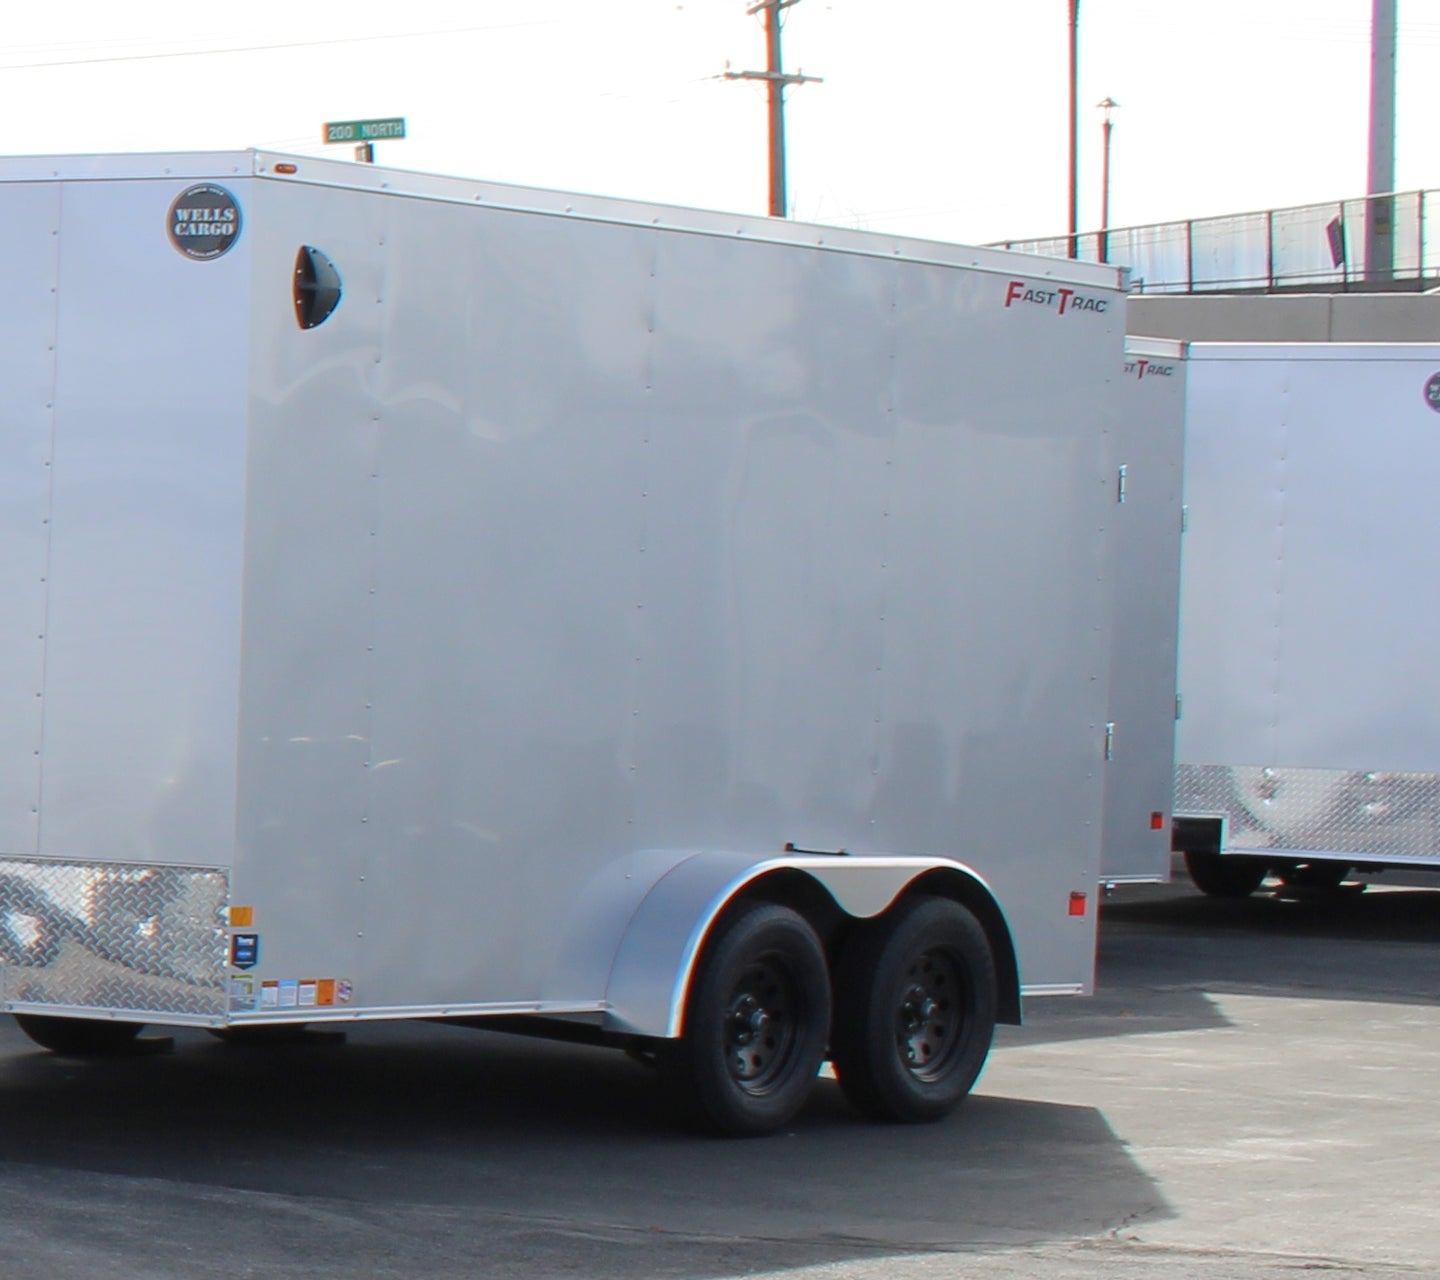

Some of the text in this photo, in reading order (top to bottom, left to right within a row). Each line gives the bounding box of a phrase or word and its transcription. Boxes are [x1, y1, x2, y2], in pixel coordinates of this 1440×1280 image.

[329, 122, 402, 140] 200 NORTH
[175, 208, 235, 222] WELLS
[174, 222, 234, 236] CARGO
[1004, 281, 1108, 315] FAST TRAC
